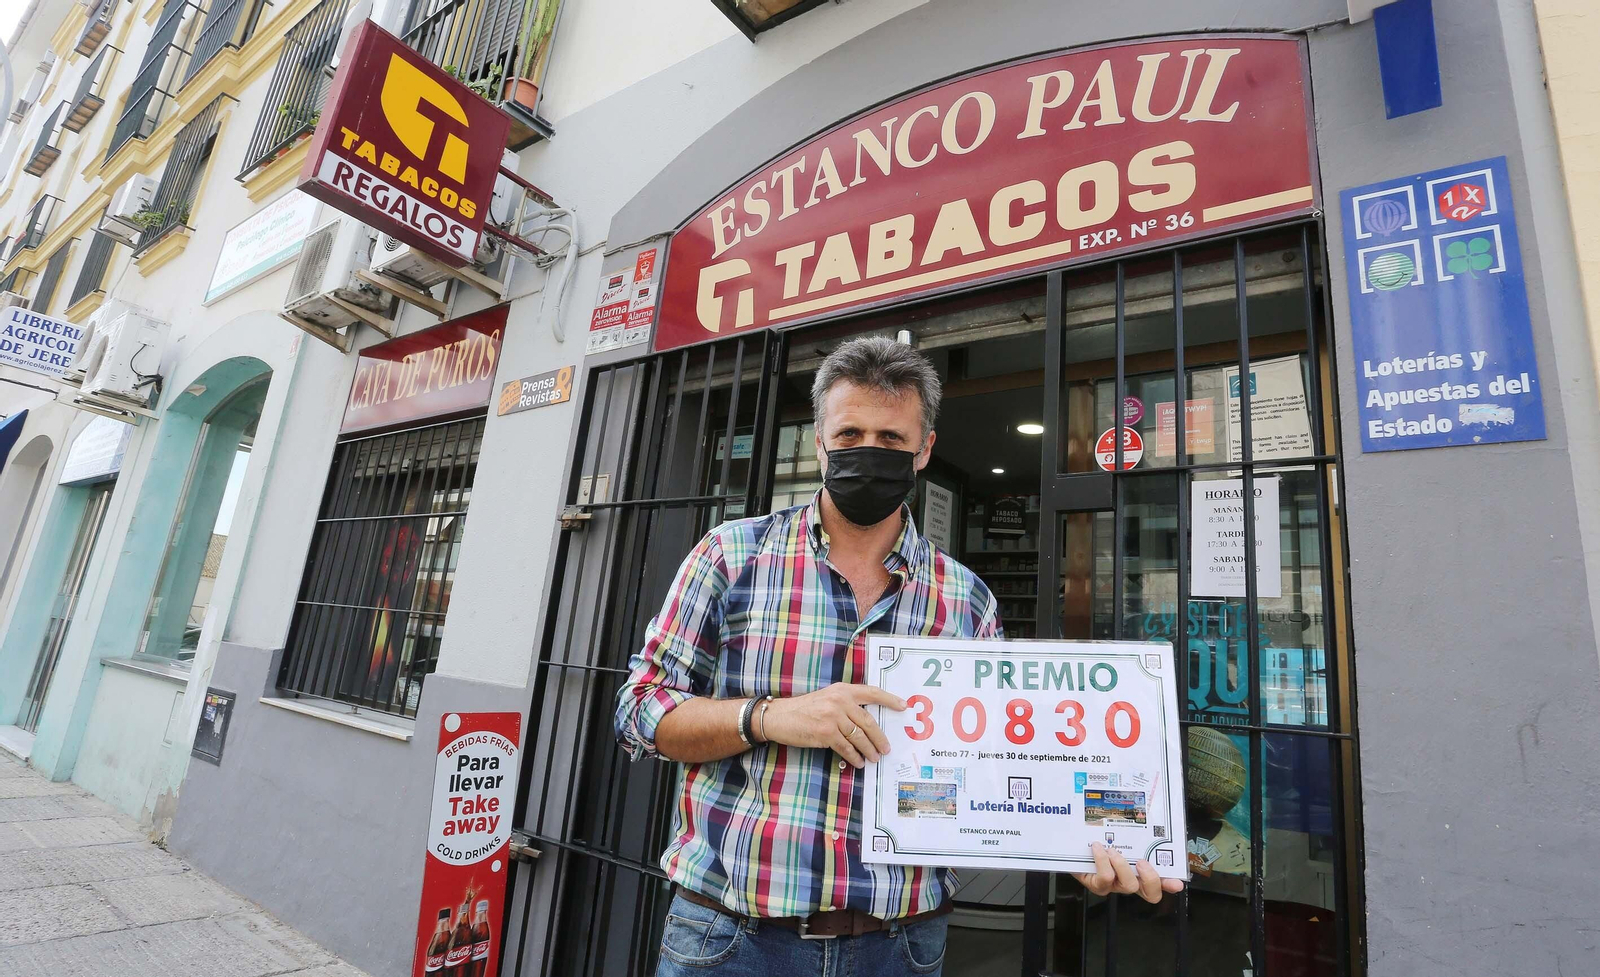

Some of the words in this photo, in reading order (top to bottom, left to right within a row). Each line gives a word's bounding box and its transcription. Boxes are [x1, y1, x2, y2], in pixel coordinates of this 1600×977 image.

[707, 91, 996, 259] ESTANCO
[1016, 48, 1241, 140] PAUL
[340, 126, 477, 219] TABACOS
[332, 161, 464, 249] REGALOS
[775, 140, 1196, 300] TABACOS
[1079, 228, 1122, 251] EXP.
[1130, 218, 1157, 240] Nº
[1165, 211, 1195, 232] 36
[593, 305, 627, 321] Alarma
[627, 309, 653, 322] Alarma
[2, 325, 77, 354] AGRICOL
[0, 339, 24, 355] DE
[28, 348, 72, 368] JERE
[1363, 351, 1463, 379] Loterías
[1471, 351, 1486, 371] y
[350, 359, 393, 411] CAVA
[393, 351, 426, 401] DE
[424, 328, 500, 394] PUROS
[518, 388, 561, 407] Revistas
[521, 377, 555, 394] Prensa
[1365, 381, 1480, 411] Apuestas
[1488, 372, 1530, 397] del
[1368, 413, 1453, 439] Estado
[1205, 488, 1262, 499] HORAO
[1213, 505, 1244, 513] MAÑAN
[1187, 602, 1209, 636] SI
[922, 658, 953, 687] 2º
[974, 659, 1119, 692] PREMIO
[445, 735, 488, 758] BEBIDAS
[489, 736, 514, 756] FRÍAS
[930, 749, 958, 758] Sorteo
[959, 750, 970, 758] 77
[978, 751, 1004, 760] jueves
[1006, 752, 1016, 760] 30
[1018, 752, 1028, 760] de
[1029, 753, 1077, 763] septiembre
[1078, 754, 1089, 762] de
[1091, 755, 1111, 763] 2021
[457, 754, 500, 772] Para
[449, 774, 503, 792] llevar
[448, 794, 500, 817] Take
[970, 799, 1014, 813] Lotería
[1017, 802, 1071, 815] Nacional
[442, 815, 501, 837] away
[436, 843, 463, 860] COLD
[465, 836, 501, 860] DRINKS
